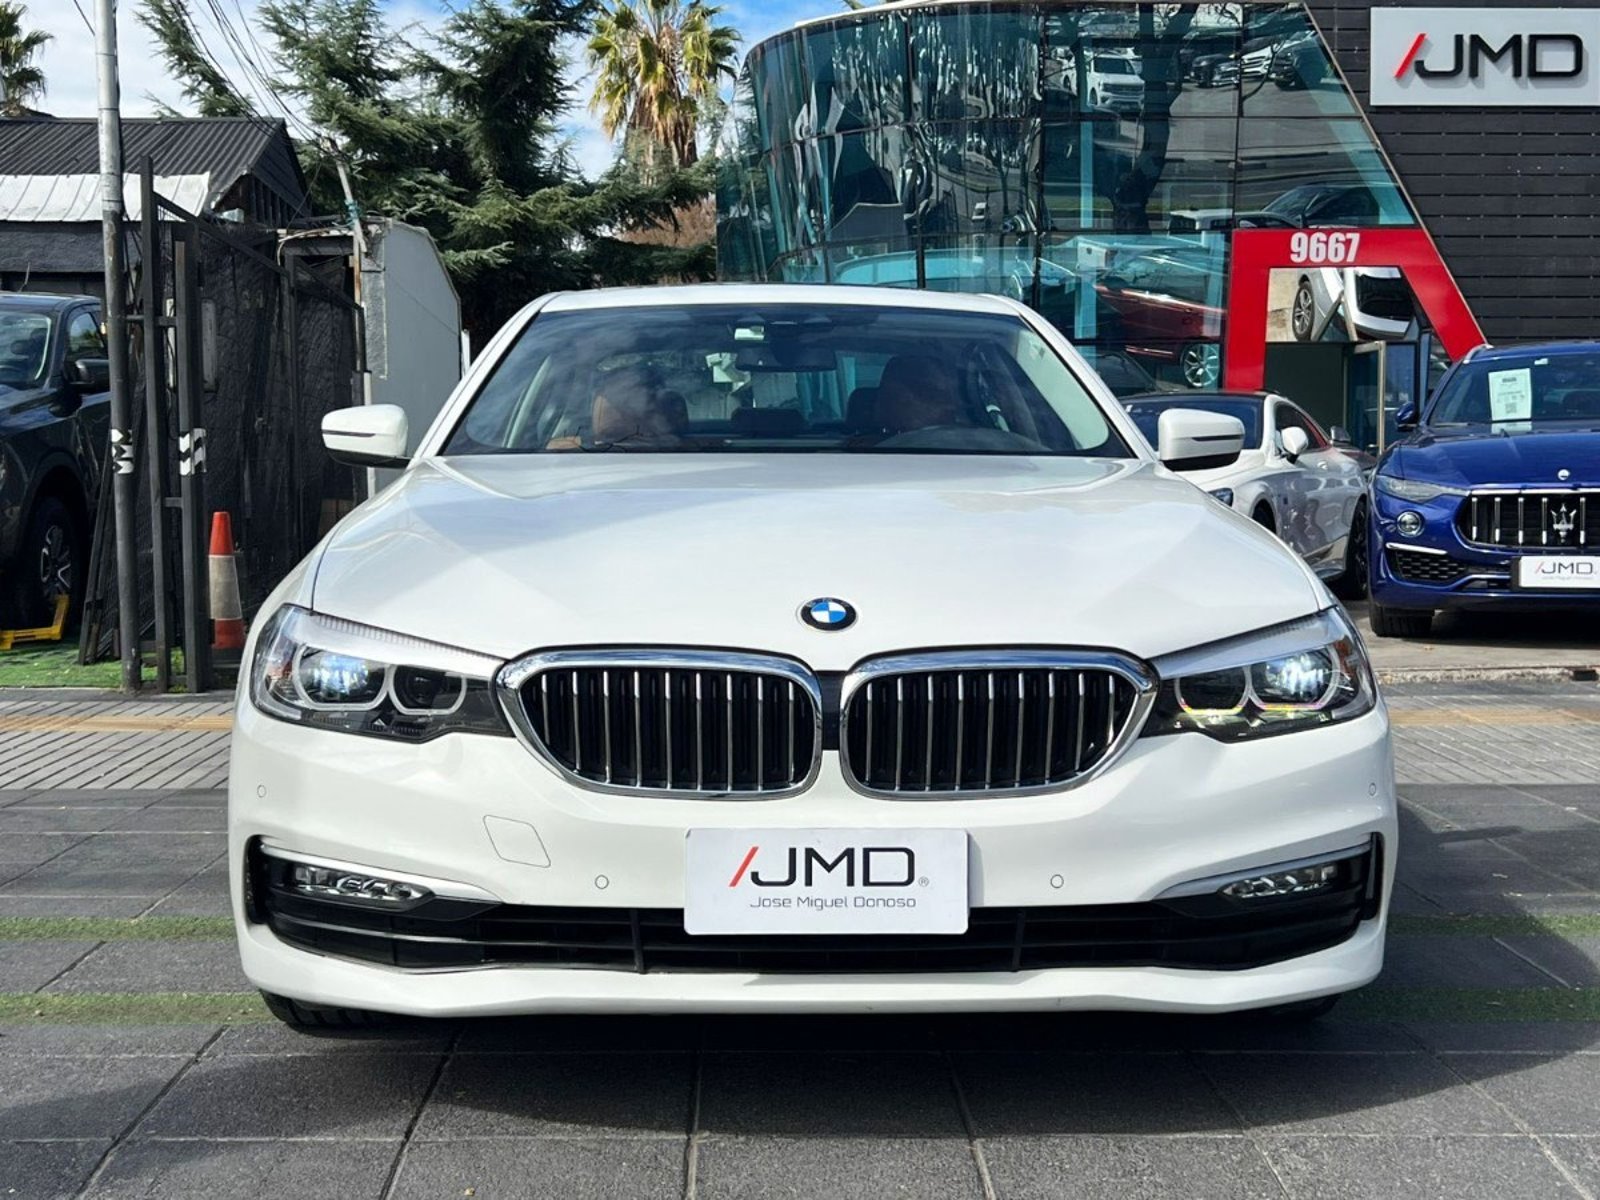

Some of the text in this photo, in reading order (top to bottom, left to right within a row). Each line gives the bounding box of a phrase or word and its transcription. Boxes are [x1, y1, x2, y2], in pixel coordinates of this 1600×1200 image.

[1290, 232, 1361, 263] 9667
[750, 895, 916, 911] Jose Miguel Donoso
